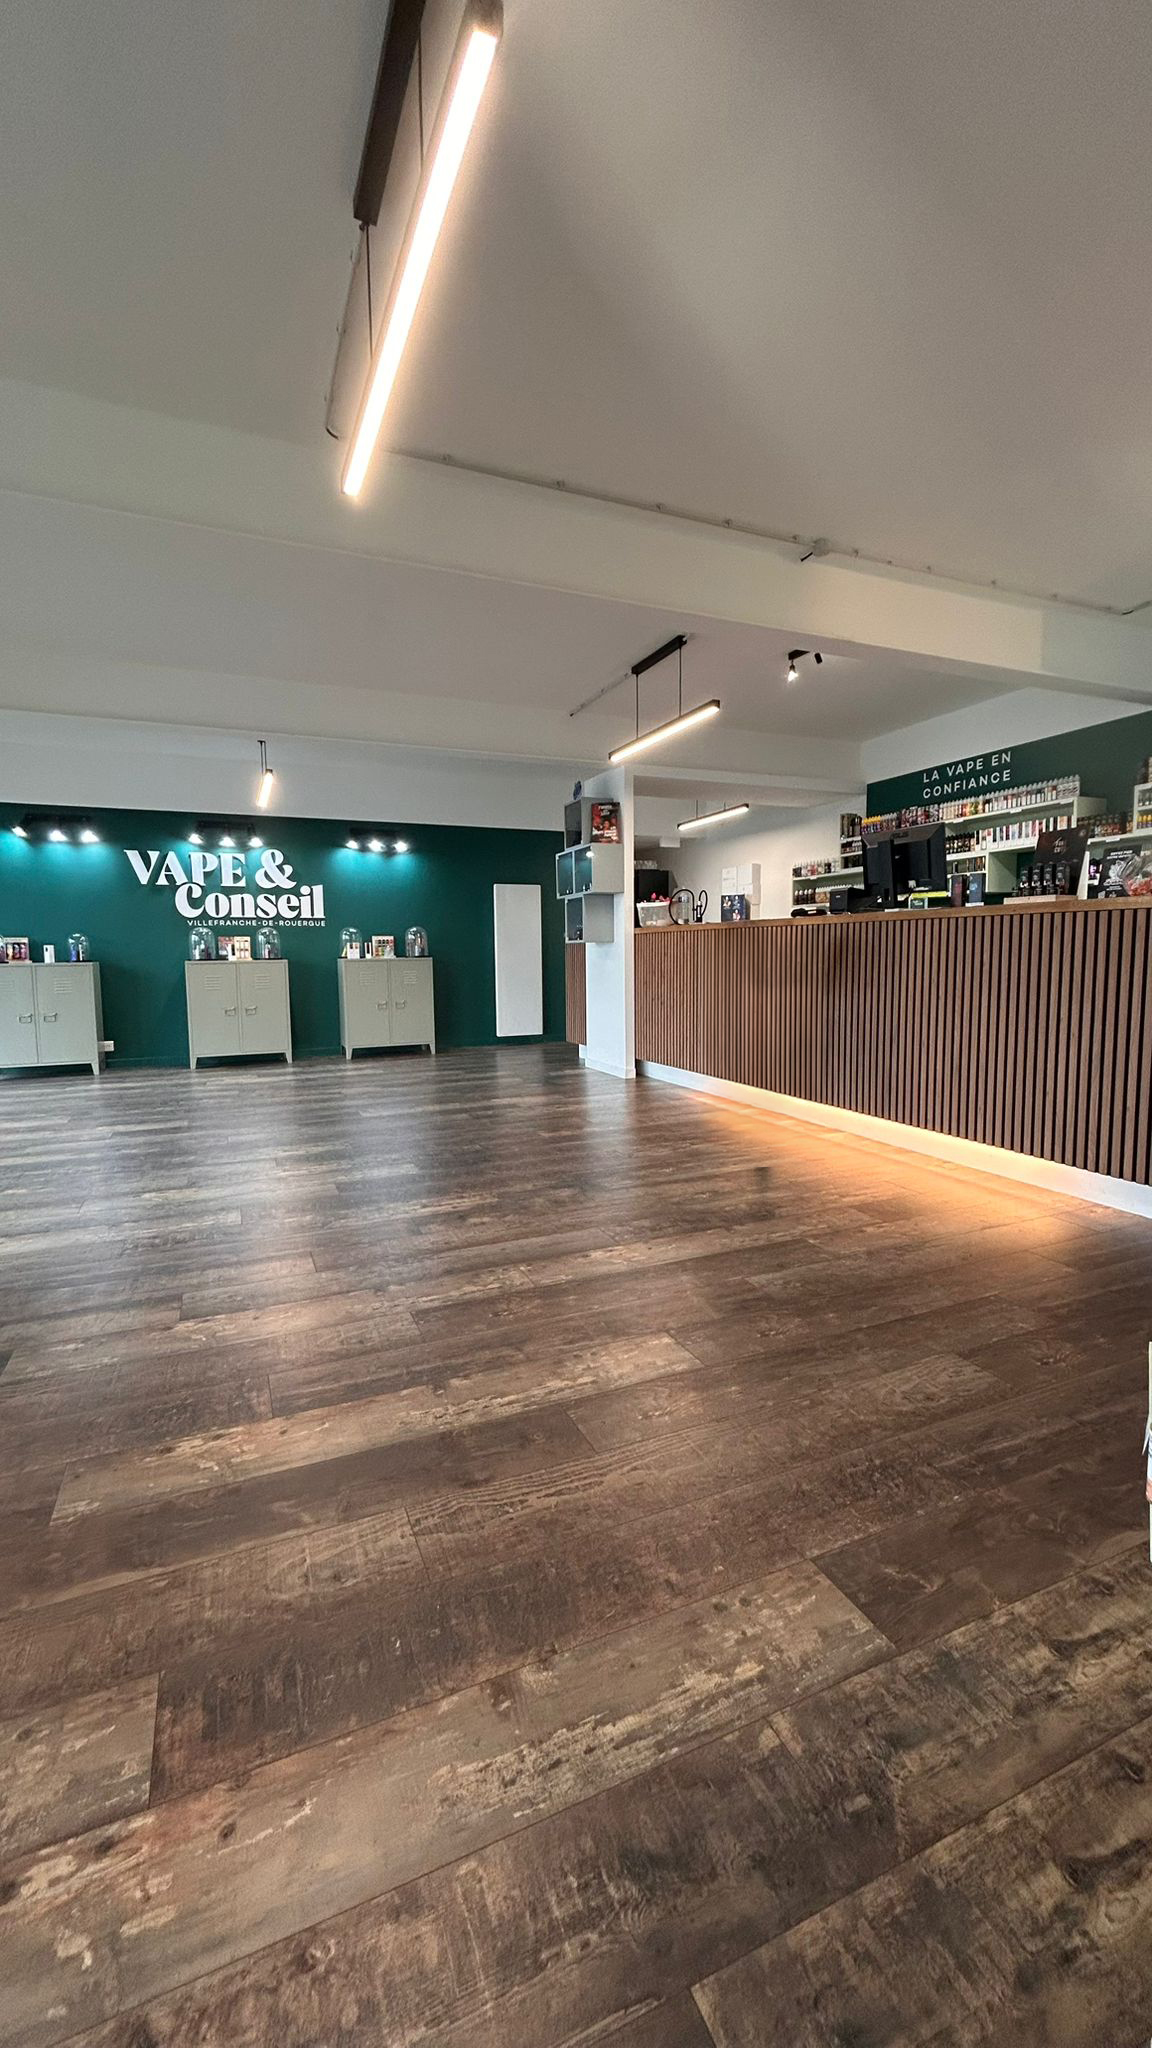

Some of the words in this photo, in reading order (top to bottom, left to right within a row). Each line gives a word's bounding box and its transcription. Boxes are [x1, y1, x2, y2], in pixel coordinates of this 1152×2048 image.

[923, 770, 940, 783] LA
[946, 758, 984, 777] VAPE
[991, 751, 1011, 767] EN
[922, 769, 1011, 799] CONFIANCE
[124, 849, 246, 887] VAPE
[255, 849, 297, 889] &
[175, 883, 326, 919] Conseil
[187, 919, 326, 927] VILLEFRANCHE-DE-ROUERGUE
